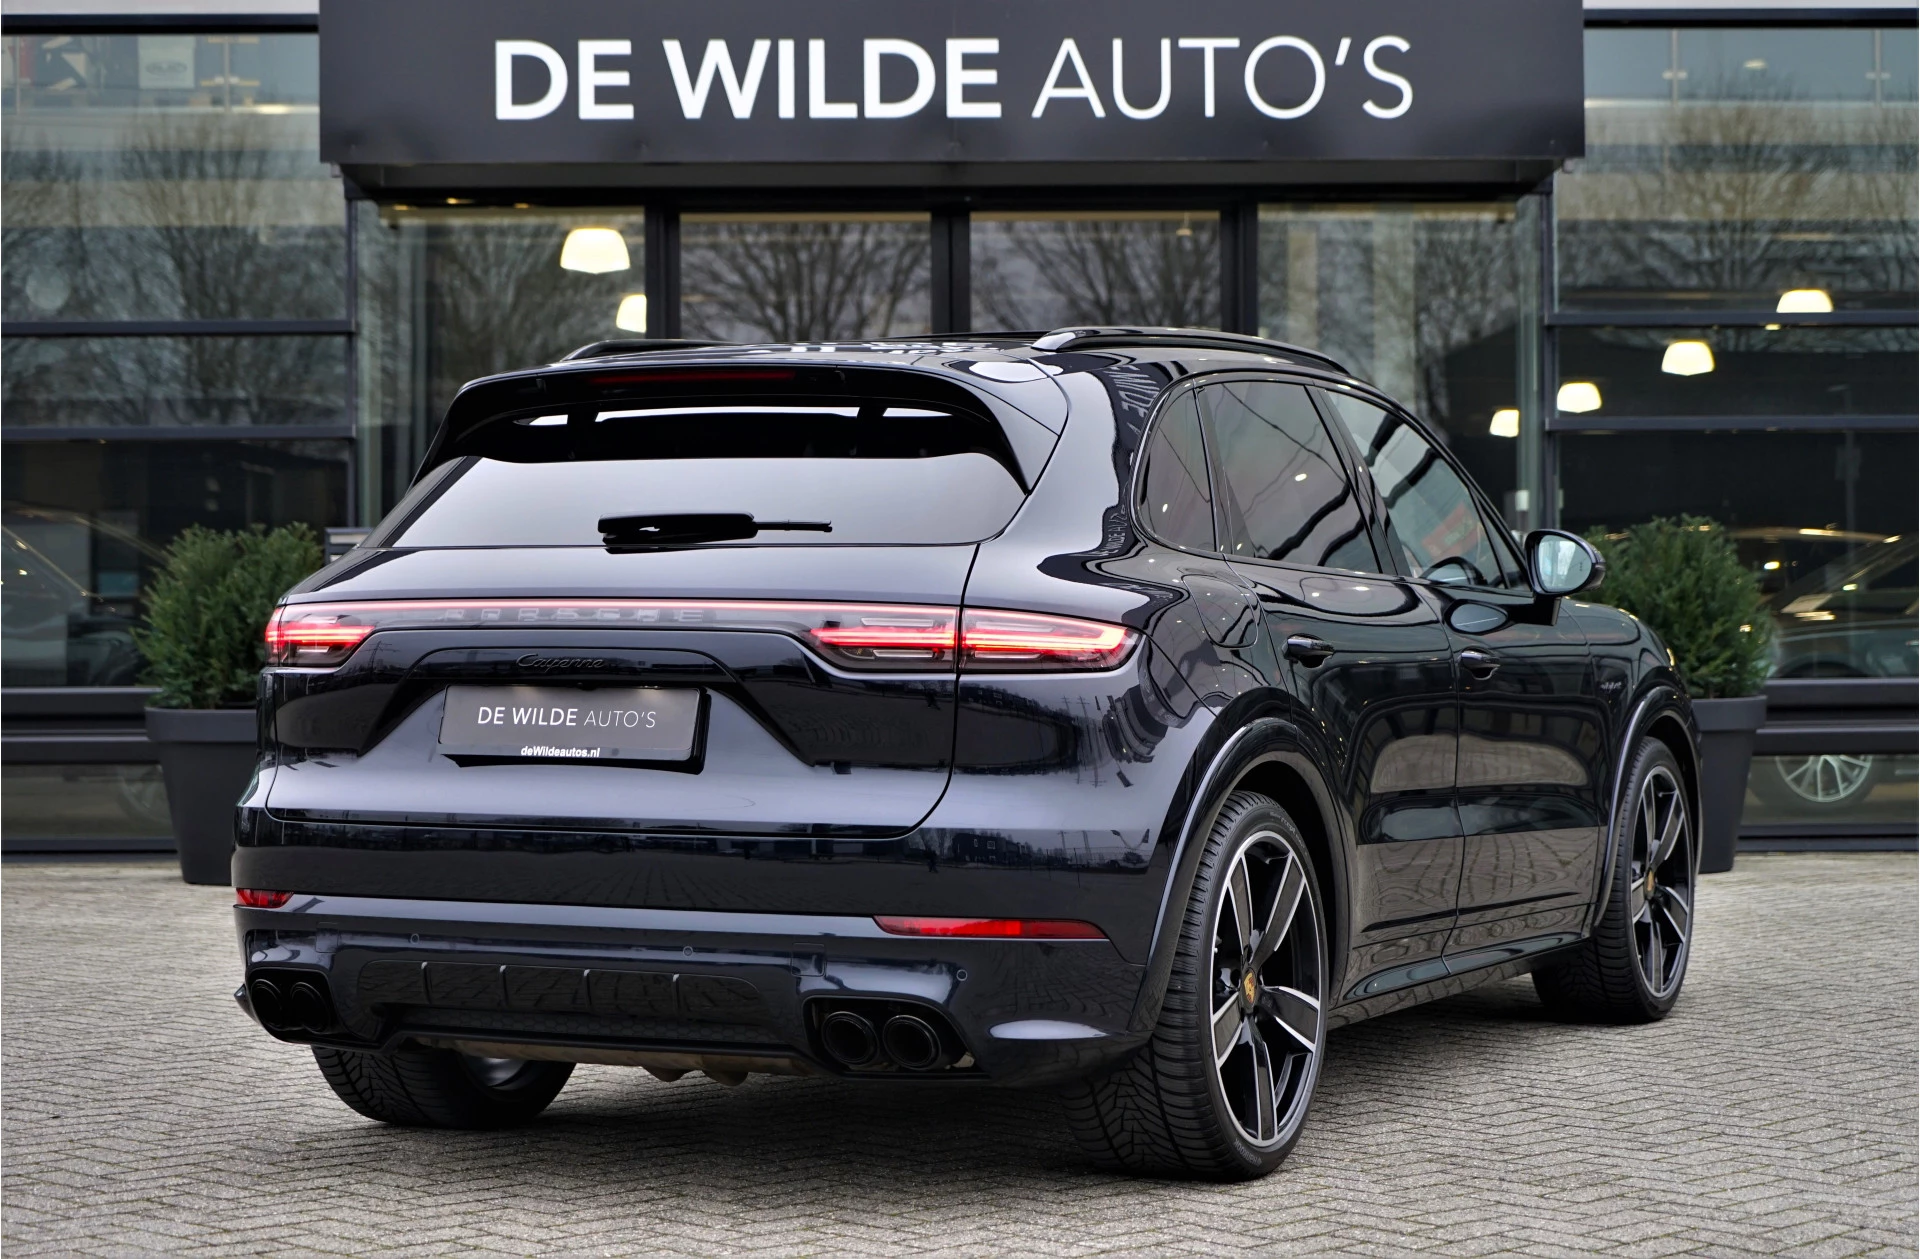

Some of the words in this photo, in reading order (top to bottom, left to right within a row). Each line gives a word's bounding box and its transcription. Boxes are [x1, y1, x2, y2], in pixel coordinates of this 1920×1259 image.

[495, 39, 635, 119] DE
[662, 38, 1002, 119] WILDE
[1031, 36, 1413, 120] AUTO'S
[516, 653, 605, 673] Cayenne
[477, 706, 506, 725] DE
[512, 707, 579, 726] WILDE
[583, 710, 657, 728] AUTO'S
[520, 745, 601, 758] deWildeautos.nl
